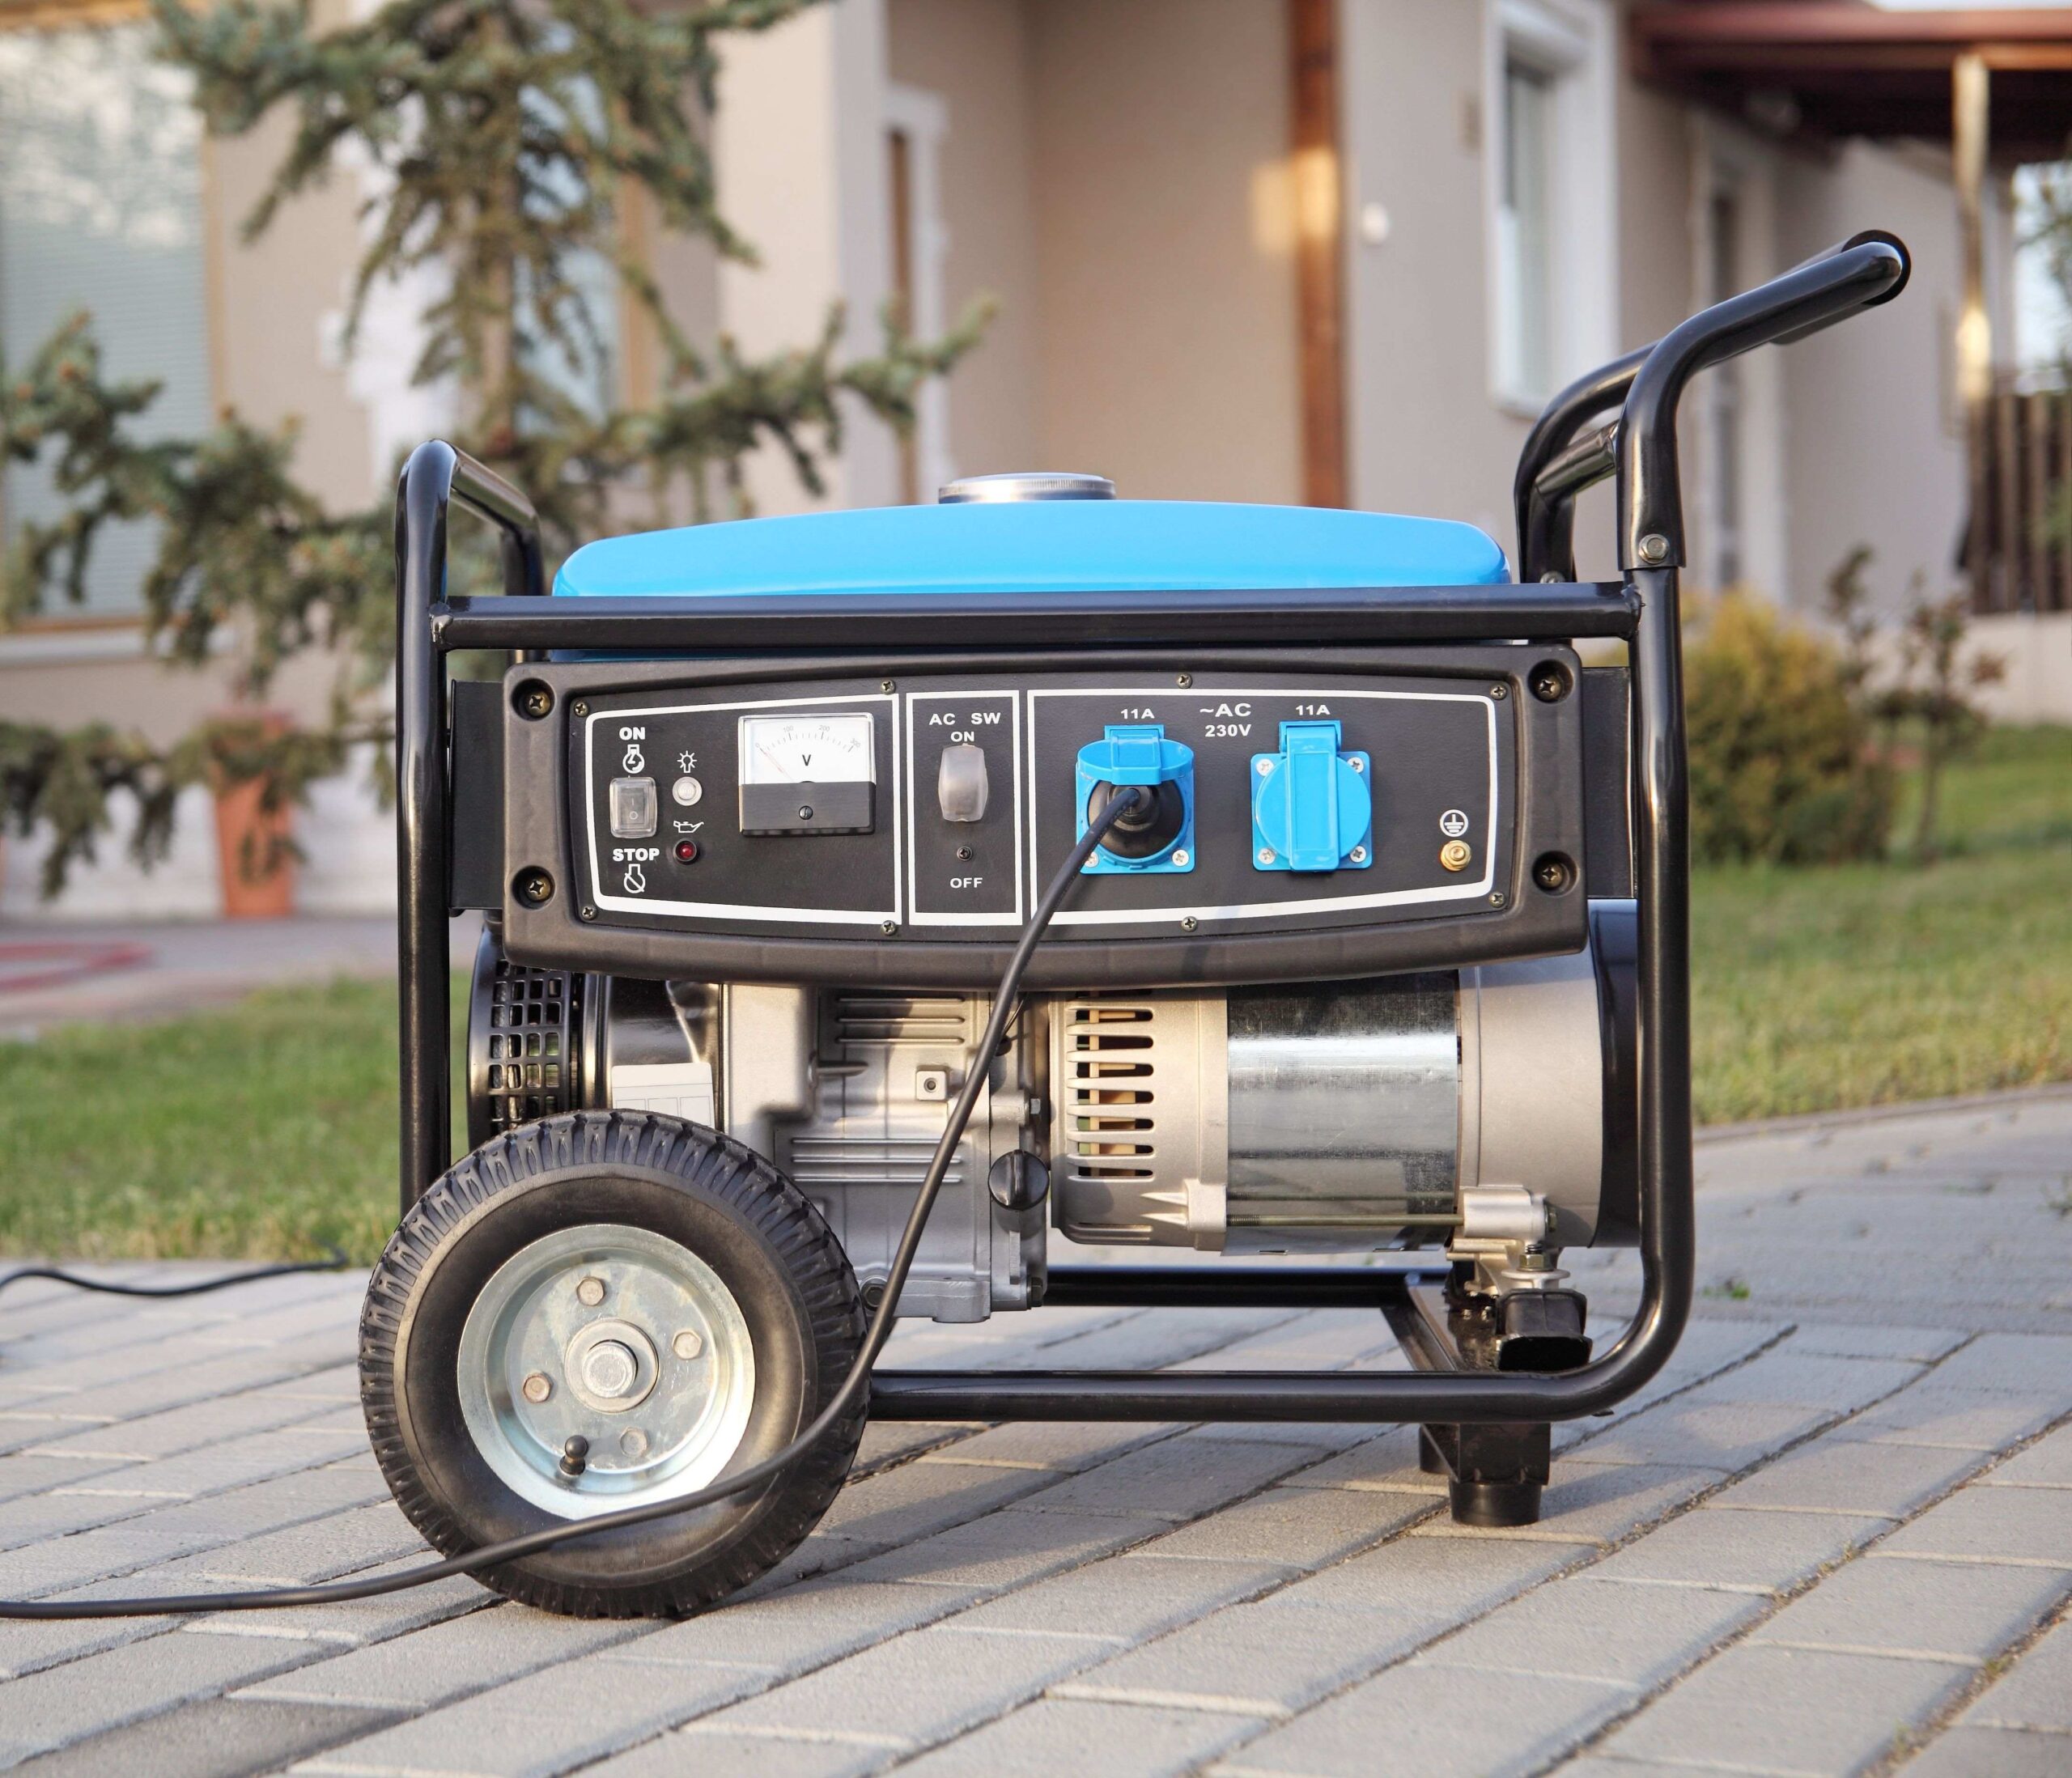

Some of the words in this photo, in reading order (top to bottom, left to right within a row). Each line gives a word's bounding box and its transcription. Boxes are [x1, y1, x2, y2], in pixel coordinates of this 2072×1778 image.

[1120, 708, 1155, 719] 11A
[1295, 704, 1331, 716] 11A
[928, 713, 956, 726] AC
[971, 712, 1001, 725] SW
[619, 727, 646, 740] ON
[950, 731, 974, 742] ON
[1204, 724, 1252, 738] 230V
[802, 754, 812, 767] V
[613, 848, 660, 862] STOP
[949, 877, 983, 889] OFF
